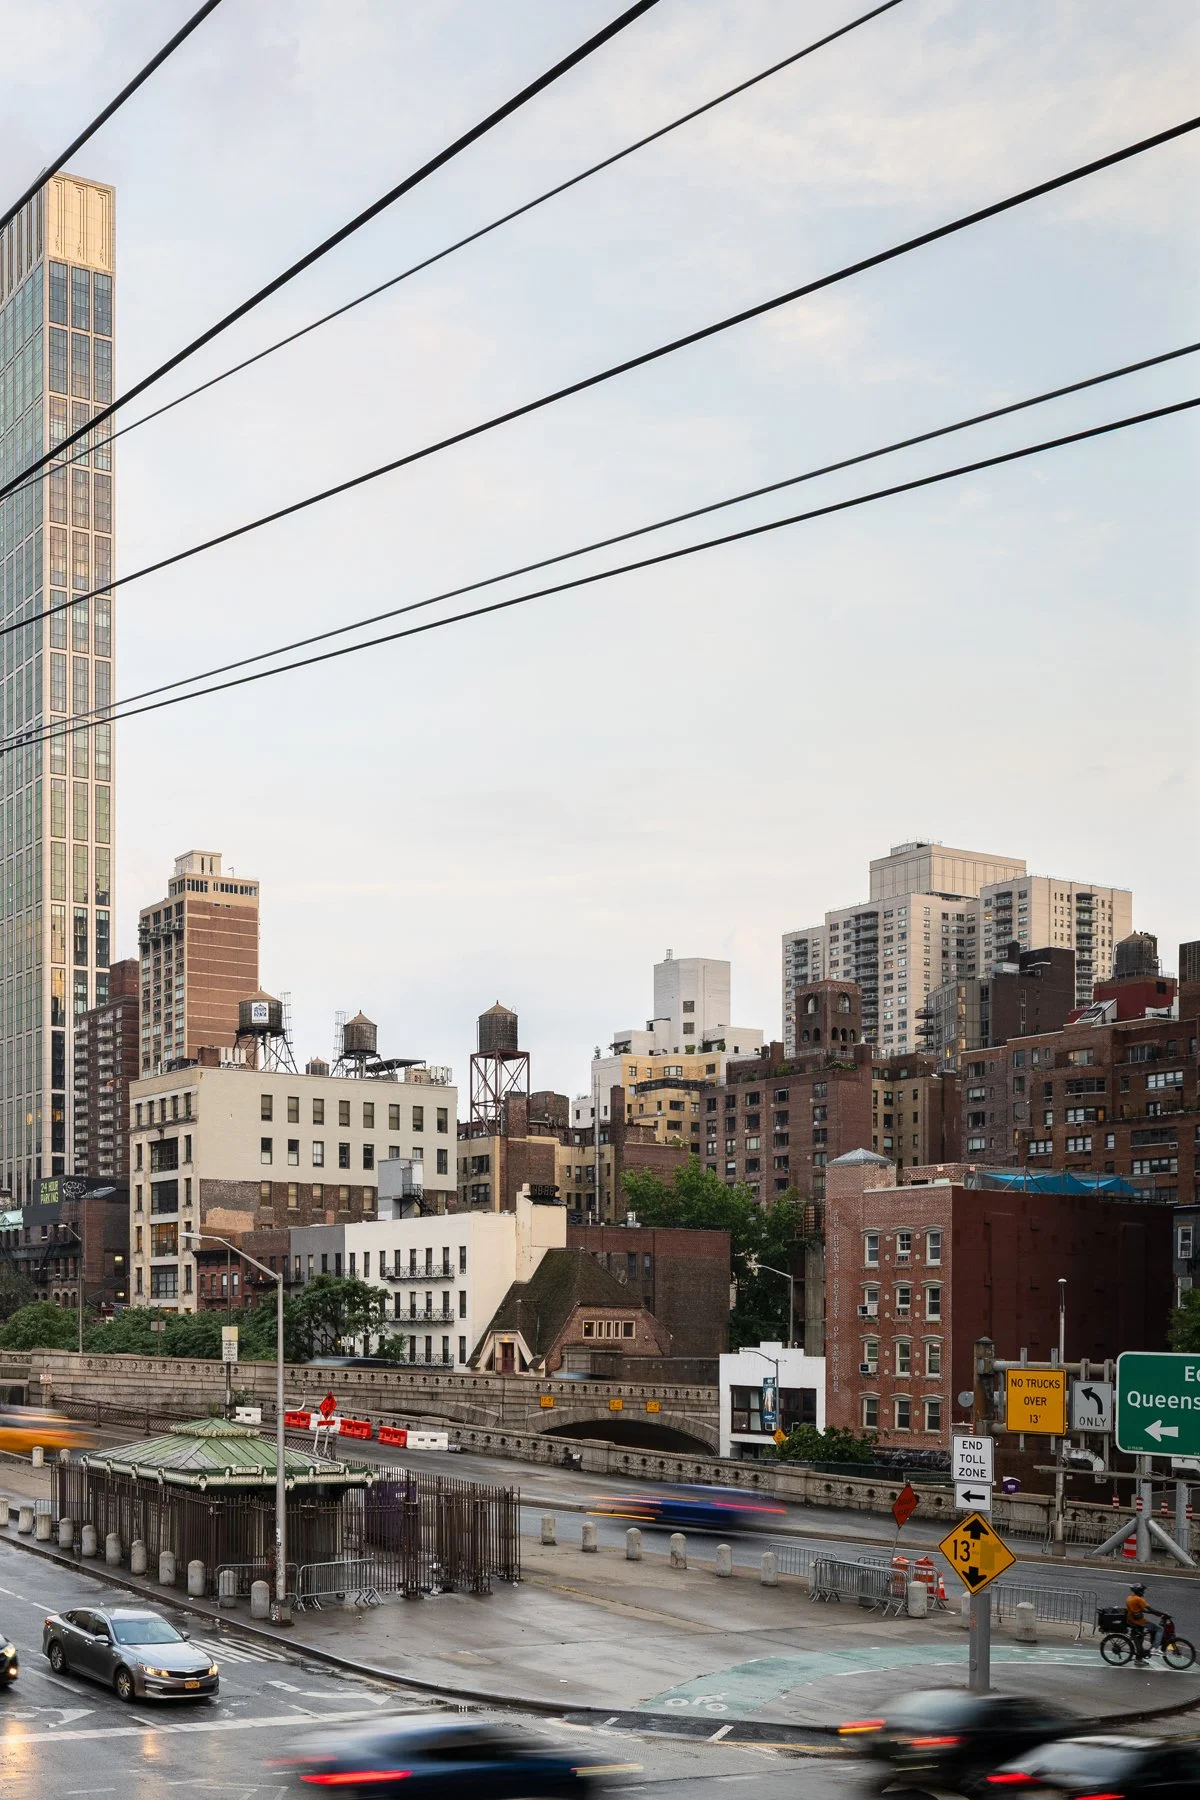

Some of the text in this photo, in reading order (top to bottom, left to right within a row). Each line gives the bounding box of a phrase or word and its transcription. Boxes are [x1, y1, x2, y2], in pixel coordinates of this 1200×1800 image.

[41, 1181, 58, 1193] 24 HOUR
[41, 1192, 58, 1204] PARKING
[1011, 1378, 1060, 1389] NO TRUCKS
[1024, 1396, 1047, 1406] OVER
[1029, 1414, 1041, 1424] 13'
[1079, 1416, 1107, 1427] ONLY
[962, 1440, 983, 1450] END
[960, 1453, 986, 1464] TOLL
[958, 1467, 987, 1478] ZONE
[952, 1539, 975, 1562] 13'
